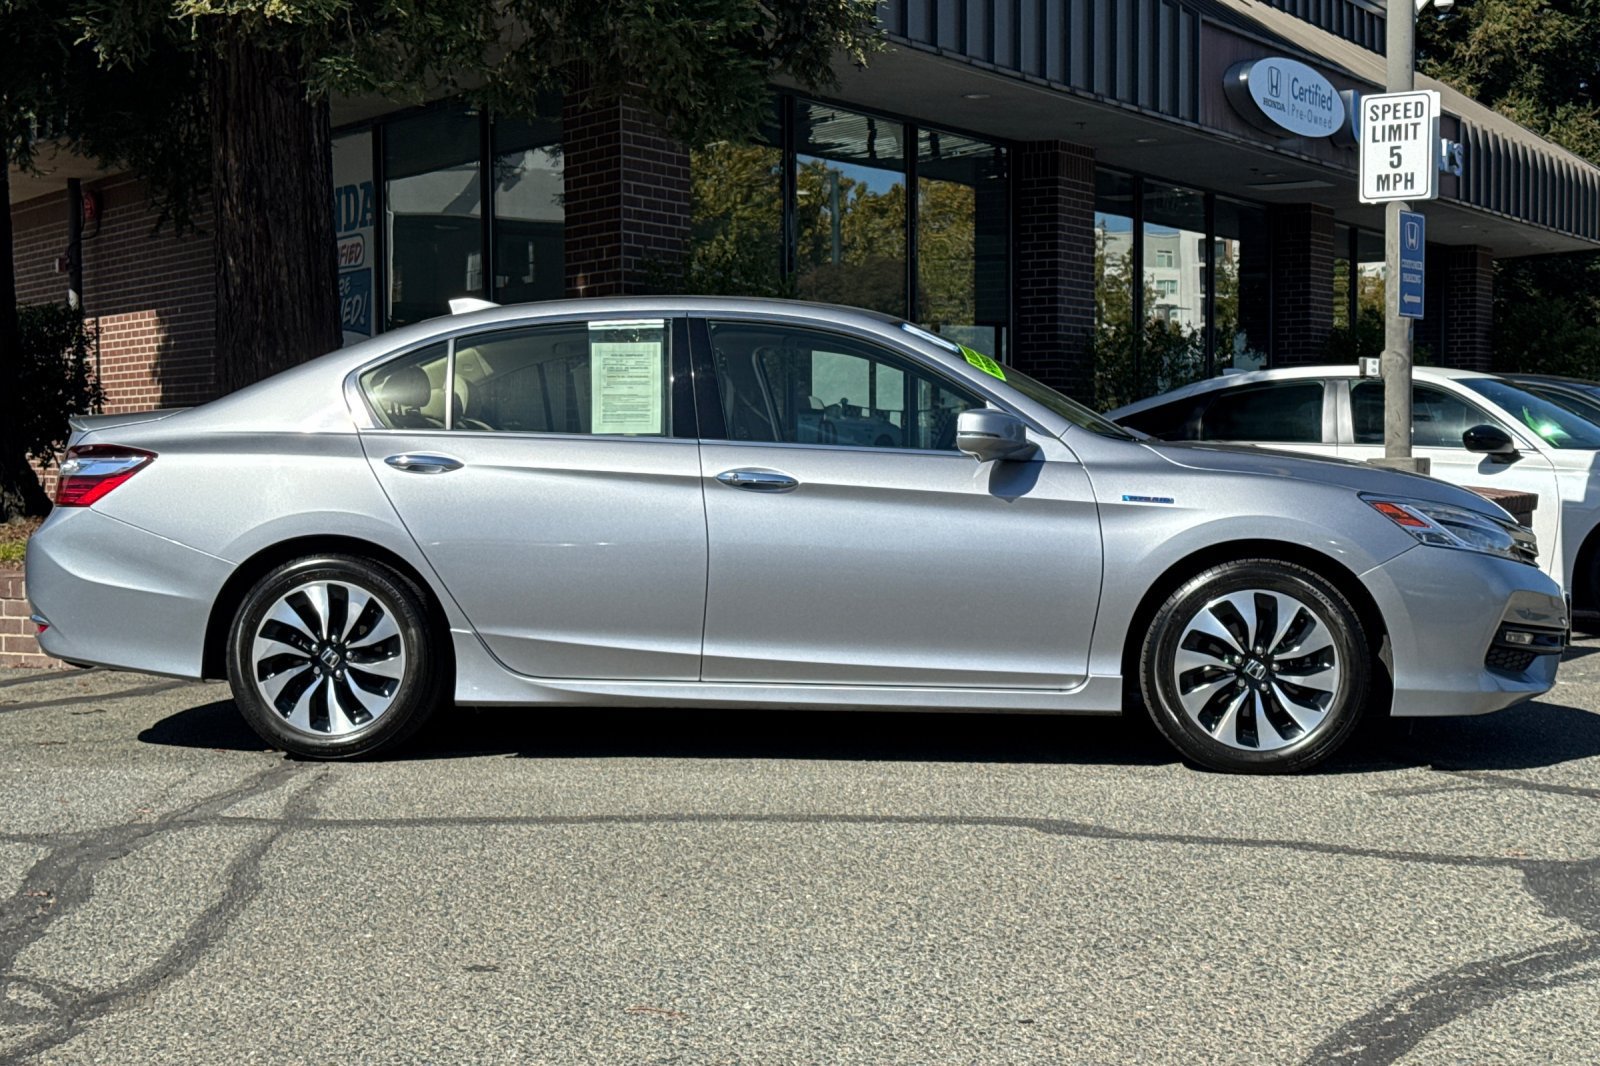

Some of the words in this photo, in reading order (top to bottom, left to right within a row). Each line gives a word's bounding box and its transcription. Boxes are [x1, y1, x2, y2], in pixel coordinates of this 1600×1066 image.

[1291, 77, 1333, 111] Certified
[1263, 97, 1286, 113] HONDA
[1369, 101, 1424, 122] SPEED
[1291, 103, 1332, 129] Pre-Owned
[1371, 122, 1421, 143] LIMIT
[1389, 145, 1402, 169] 5
[1376, 172, 1415, 192] MPH
